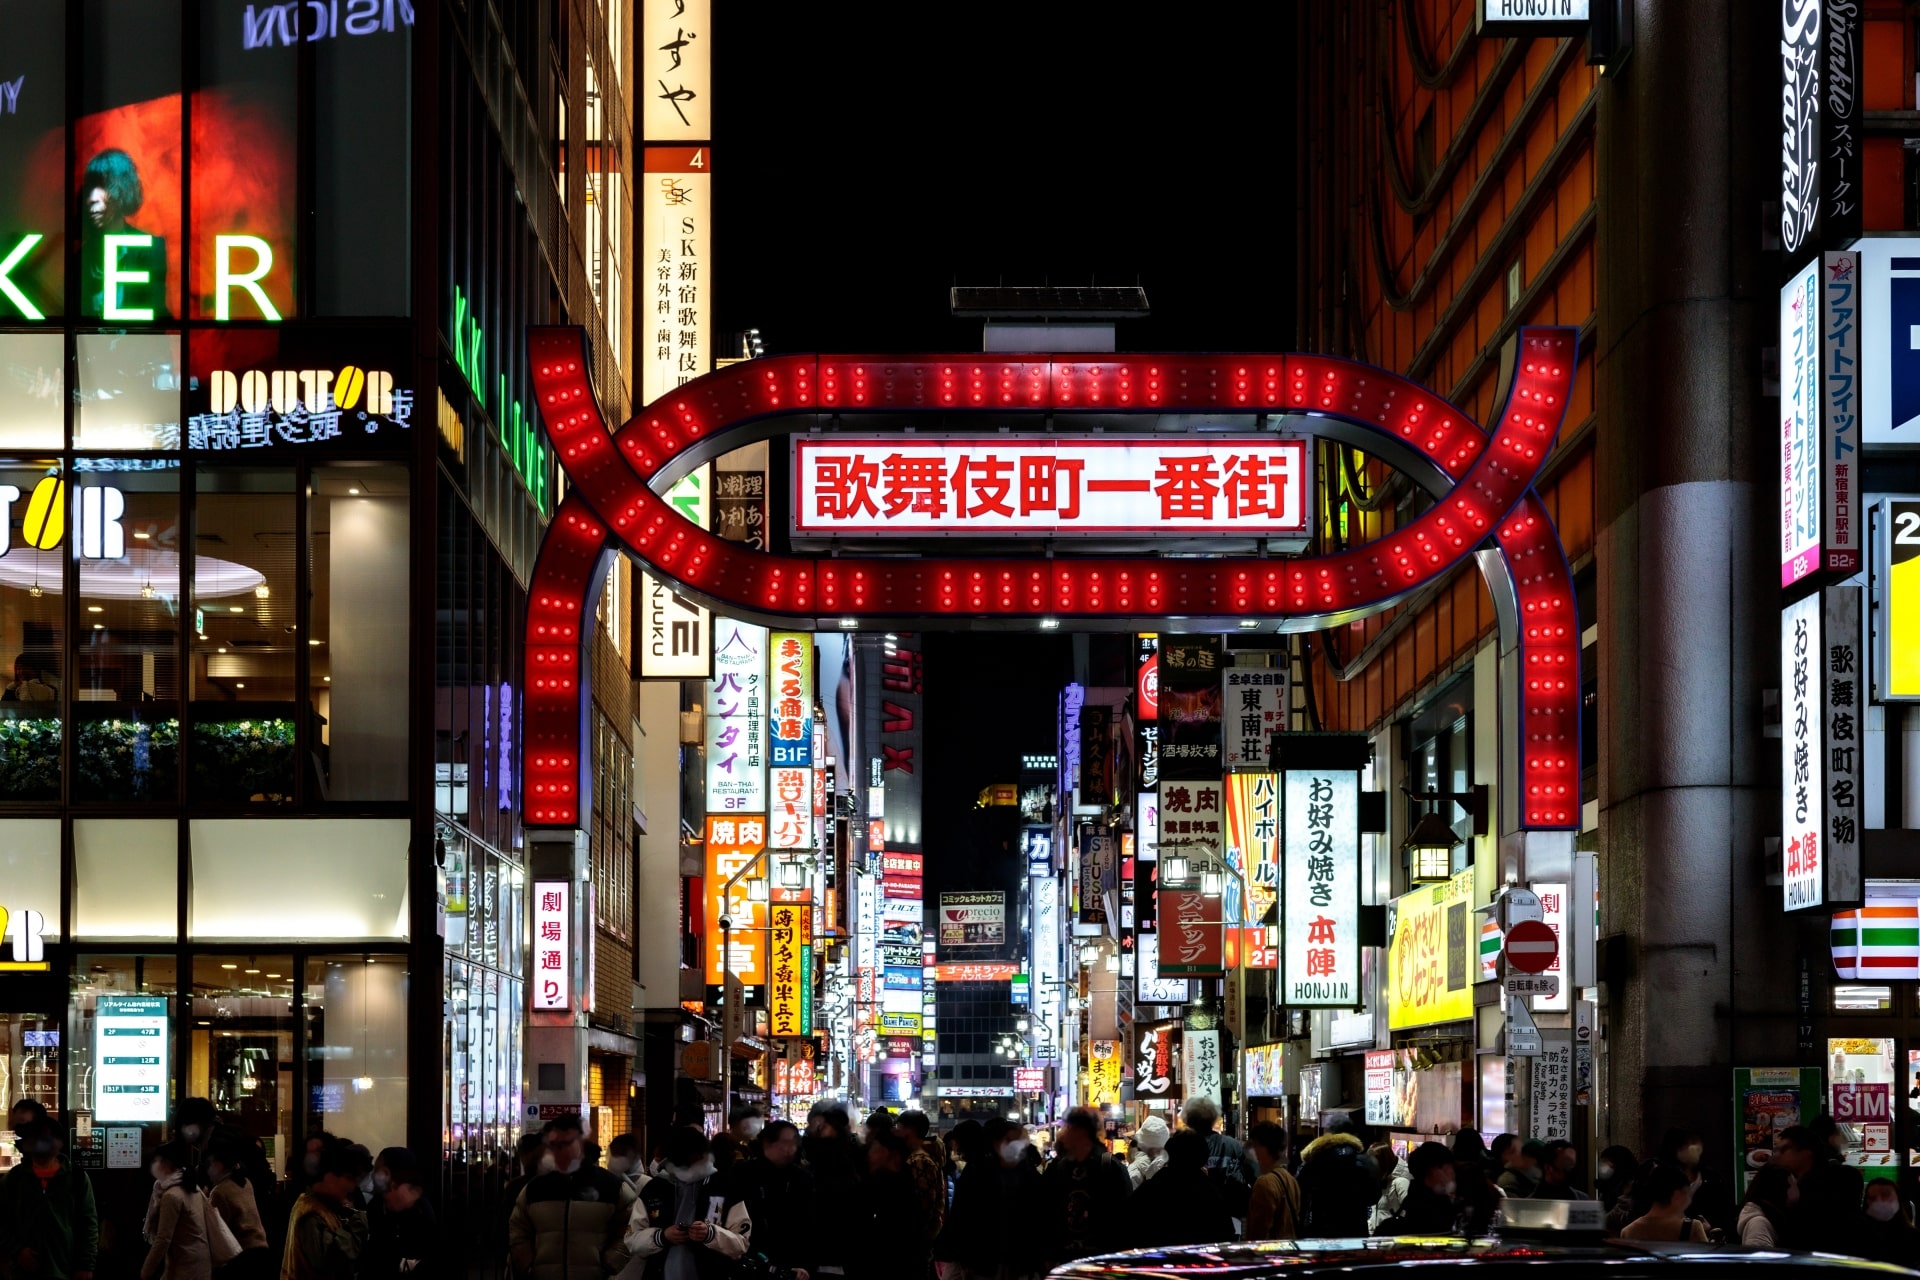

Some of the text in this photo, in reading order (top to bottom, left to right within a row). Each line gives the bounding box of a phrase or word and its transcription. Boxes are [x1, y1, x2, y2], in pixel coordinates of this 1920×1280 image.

[1502, 0, 1571, 16] HONJIN
[1827, 0, 1857, 119] Sparkle
[690, 149, 703, 169] 4
[1799, 49, 1819, 246] スパークル
[1829, 124, 1855, 217] スパークル
[657, 248, 671, 361] 美容外科・歯科
[211, 366, 394, 414] DOUTOR
[1828, 283, 1854, 459] ファイトフィット
[1793, 326, 1804, 548] ファイトフィット
[815, 452, 1288, 520] 歌舞伎町一番街
[1835, 464, 1849, 545] 新宿東口駅前
[1793, 559, 1809, 580] B2F
[1829, 554, 1854, 567] B2F
[652, 577, 664, 657] NJUKU
[1139, 654, 1149, 662] 4F
[1228, 673, 1285, 686] 全卓全自動
[779, 639, 803, 740] まぐろ商店
[714, 672, 743, 774] バンタイ
[748, 673, 759, 767] タイ国料理専門店
[1240, 688, 1262, 762] 東南荘
[1794, 618, 1809, 824] お好み焼き
[774, 747, 808, 762] B1F
[1162, 744, 1219, 758] 酒場牧場
[1229, 752, 1239, 761] 3F
[1830, 645, 1855, 844] 歌舞伎町名物
[724, 798, 746, 809] 3F
[1164, 786, 1220, 813] 焼肉
[710, 820, 763, 846] 焼肉
[1086, 826, 1107, 835] 麻雀
[1254, 778, 1276, 883] ハイボール
[1307, 777, 1335, 907] お好み焼き
[1091, 836, 1102, 909] SLUSH
[1787, 831, 1818, 878] 本陣
[780, 891, 801, 900] 4F
[942, 894, 1003, 903] コミック&ネットカフェ
[1788, 879, 1816, 908] HONJIN
[1088, 913, 1104, 922] 4F
[1178, 893, 1206, 963] ステップ
[1414, 905, 1442, 959] やきとり
[541, 891, 562, 999] 劇場通り
[1252, 951, 1276, 965] 2F
[1307, 915, 1336, 977] 本陣
[947, 966, 1019, 974] ゴールドラッシュ
[1295, 982, 1348, 999] HONJIN
[1414, 960, 1444, 1008] センター
[1508, 980, 1555, 993] 自転車を除く
[1800, 1025, 1812, 1036] 17
[1533, 1063, 1541, 1088] Security
[1559, 1046, 1568, 1137] みなさまの安全を守り
[1838, 1092, 1885, 1116] SIM
